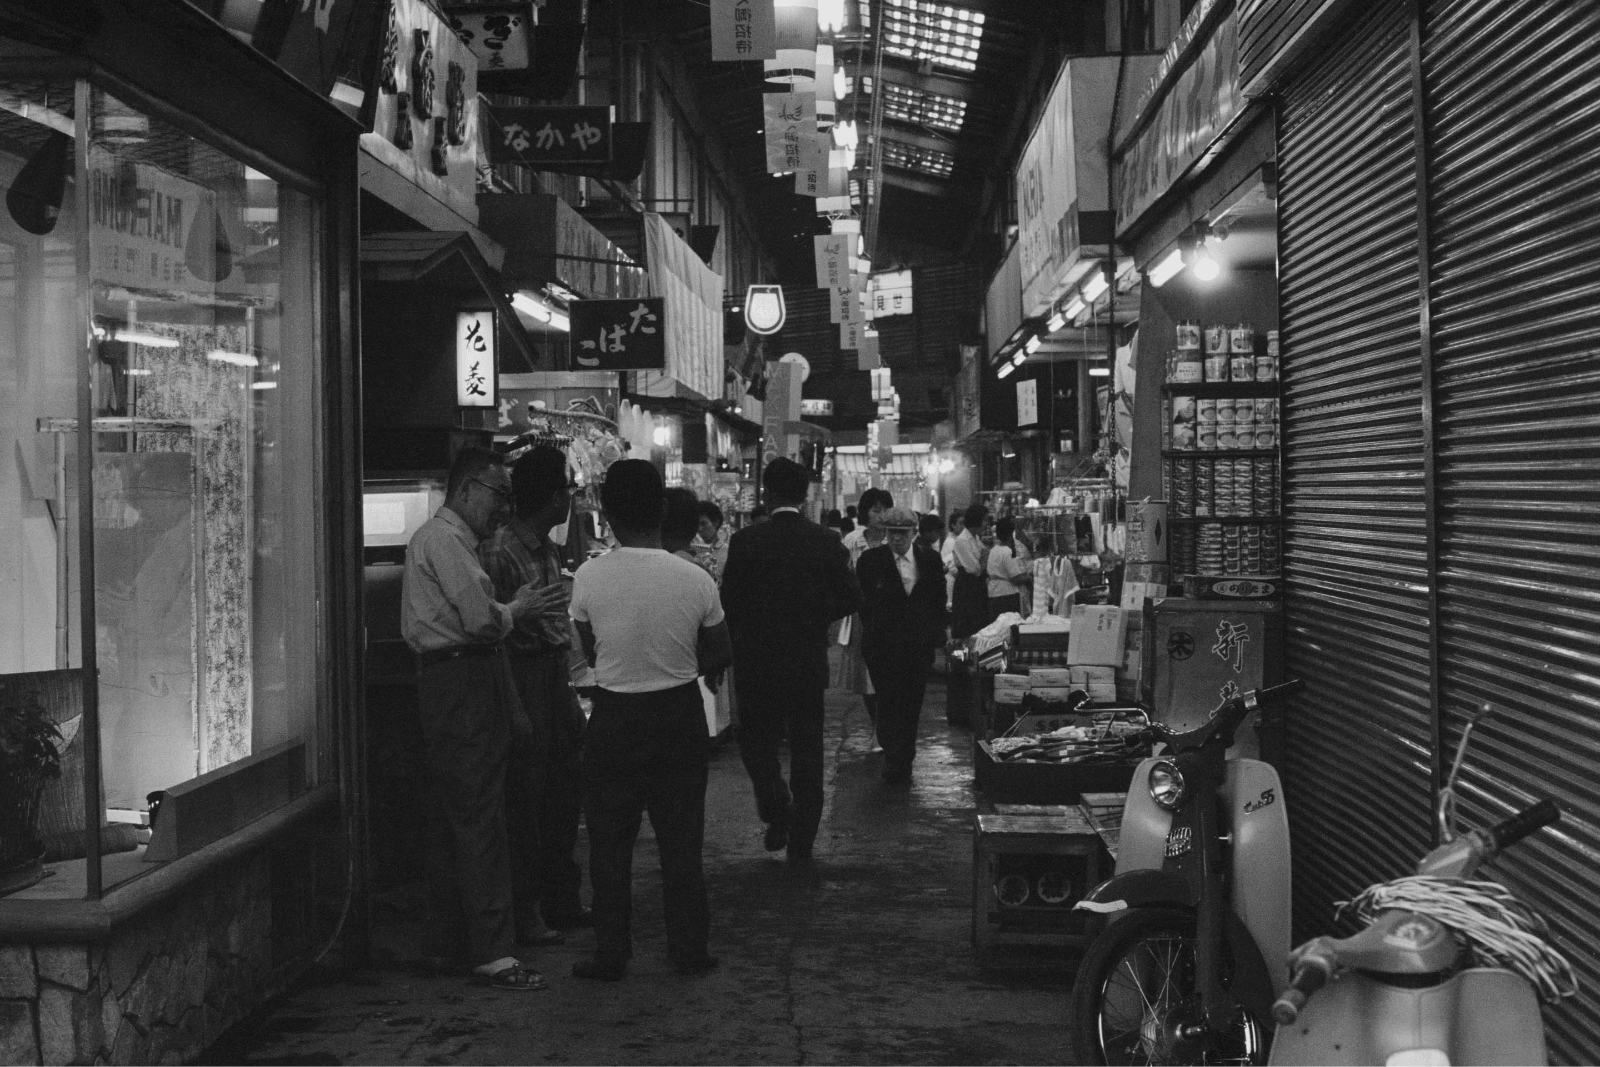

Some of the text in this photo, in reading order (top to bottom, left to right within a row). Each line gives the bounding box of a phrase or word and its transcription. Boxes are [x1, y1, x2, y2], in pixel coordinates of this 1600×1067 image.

[503, 121, 602, 152] なかや
[576, 302, 657, 367] たばこ
